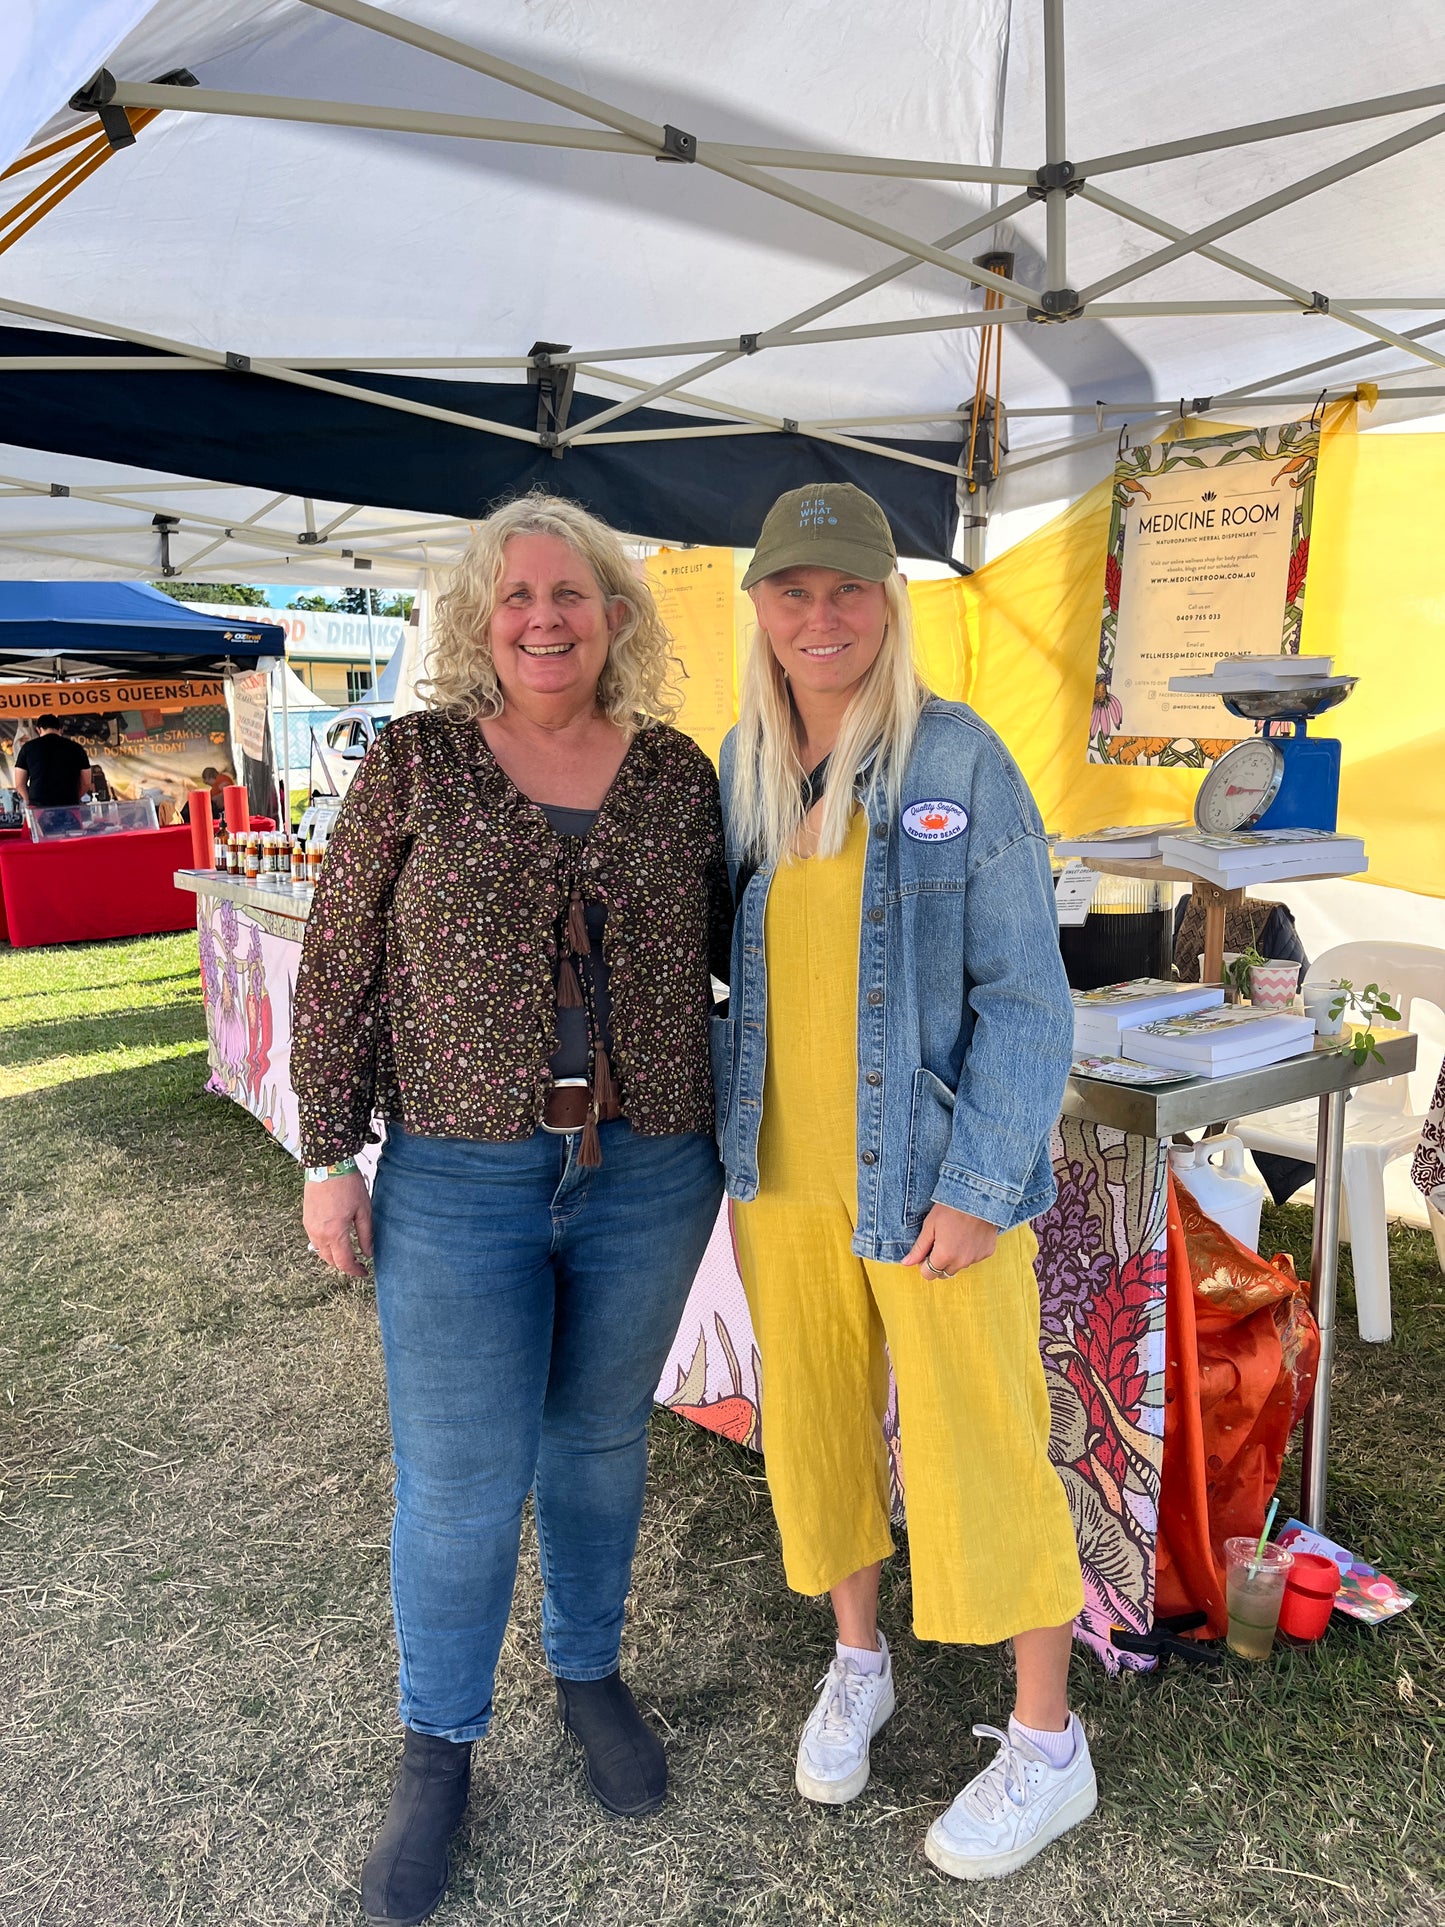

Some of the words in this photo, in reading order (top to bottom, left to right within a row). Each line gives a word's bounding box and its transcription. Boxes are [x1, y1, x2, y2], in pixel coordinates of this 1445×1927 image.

[801, 500, 809, 508] IT
[800, 507, 832, 517] WHAT
[1138, 509, 1216, 534] MEDICINE
[1221, 502, 1280, 527] ROOM
[800, 518, 809, 528] IT
[813, 516, 824, 525] IS
[1156, 536, 1198, 545] NATUROPATHIC
[1199, 534, 1220, 542] HERBAL
[1221, 531, 1257, 540] DISPENSARY
[1204, 556, 1215, 565] shop
[1224, 554, 1236, 562] body
[671, 565, 688, 575] PRICE
[690, 563, 703, 573] LIST
[1185, 564, 1197, 573] blogs
[1150, 571, 1256, 584] WWW.MEDICINEROOM.COM.AU
[1208, 613, 1221, 621] 033
[327, 621, 400, 647] DRINKS
[0, 693, 54, 709] GUIDE
[59, 689, 111, 706] DOGS
[103, 745, 147, 757] DONATE
[150, 742, 186, 753] TODAY!
[910, 803, 936, 816] Quality
[936, 802, 963, 817] Seafood
[907, 826, 938, 839] REDONDO
[940, 825, 961, 839] BEACH
